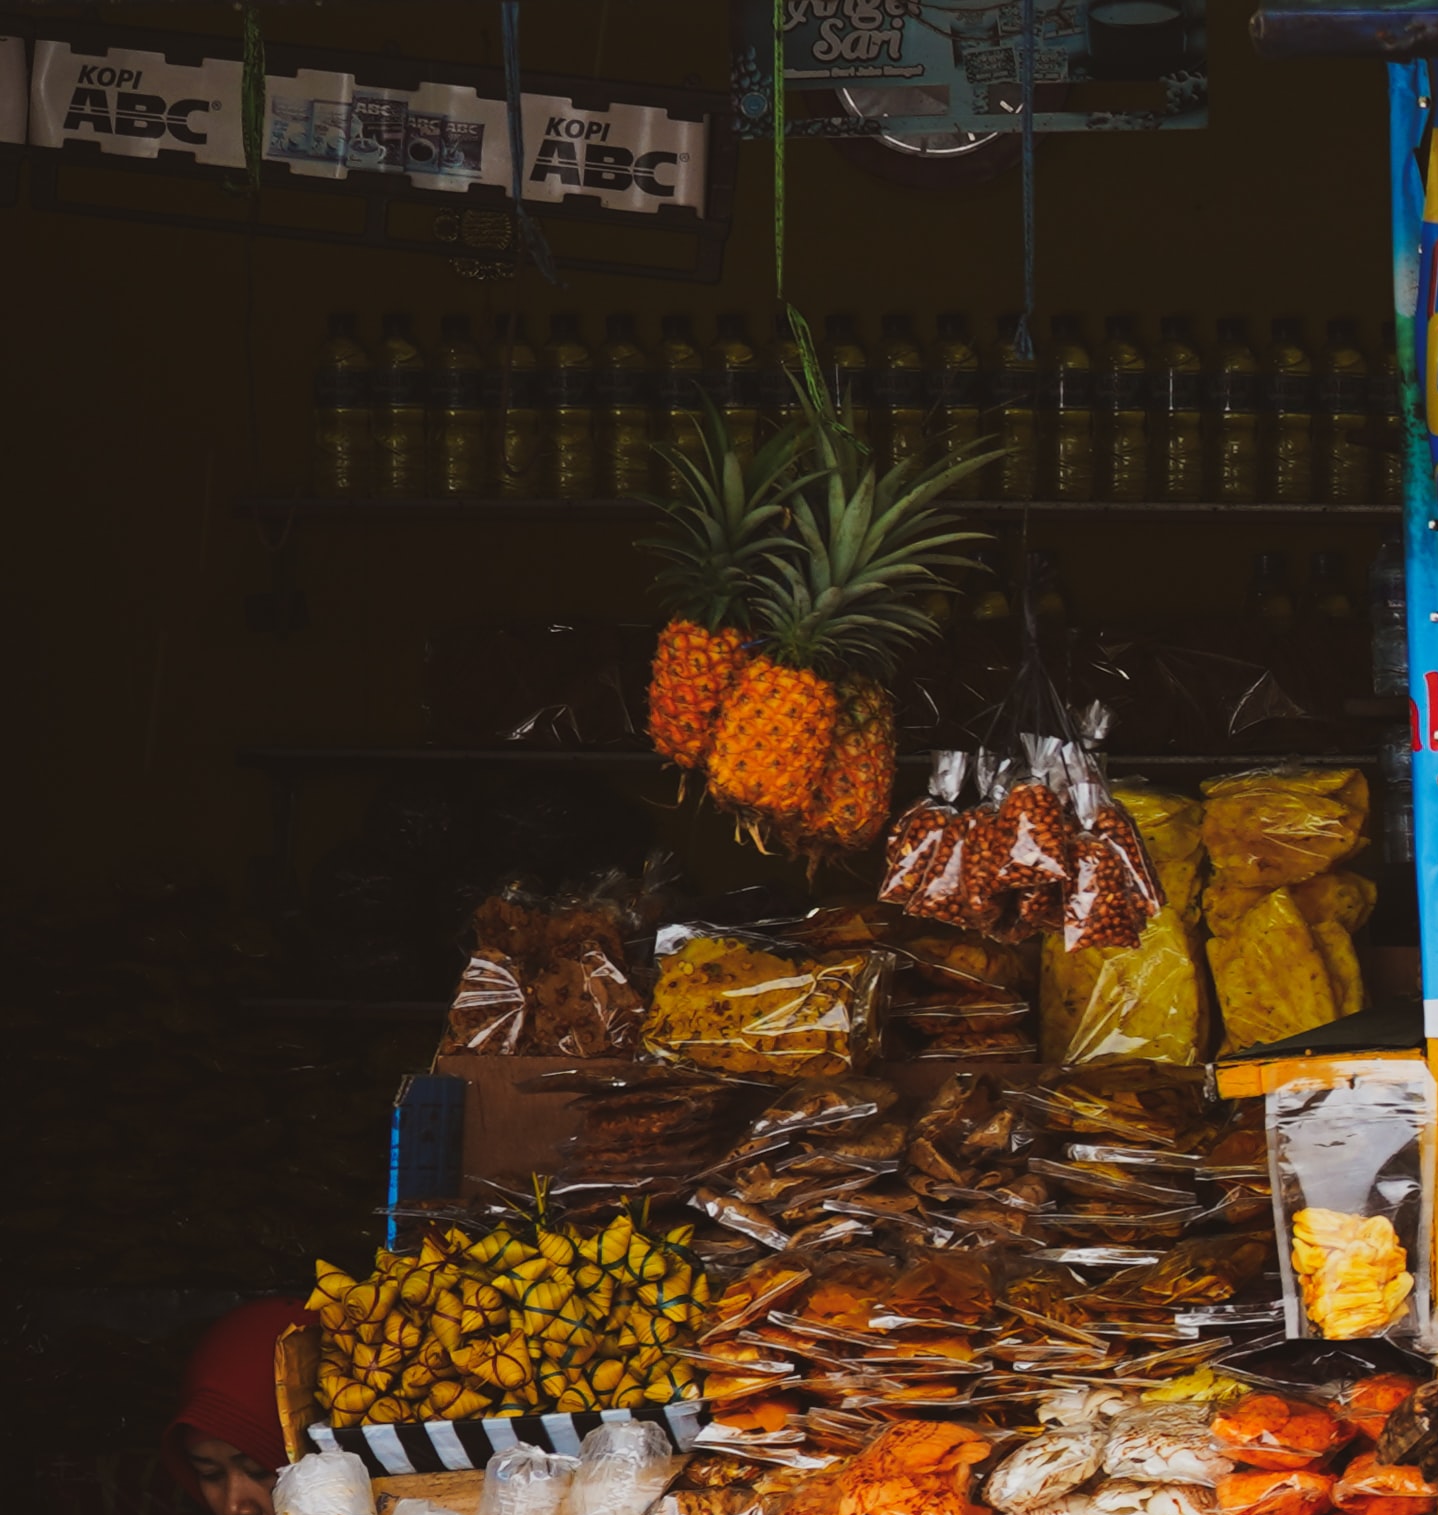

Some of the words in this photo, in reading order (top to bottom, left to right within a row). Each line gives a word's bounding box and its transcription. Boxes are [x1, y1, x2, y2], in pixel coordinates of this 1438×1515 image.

[813, 18, 905, 62] Sari
[78, 66, 142, 89] KOPI
[63, 87, 210, 144] ABC
[545, 118, 610, 141] KOPI
[529, 139, 677, 197] ABC
